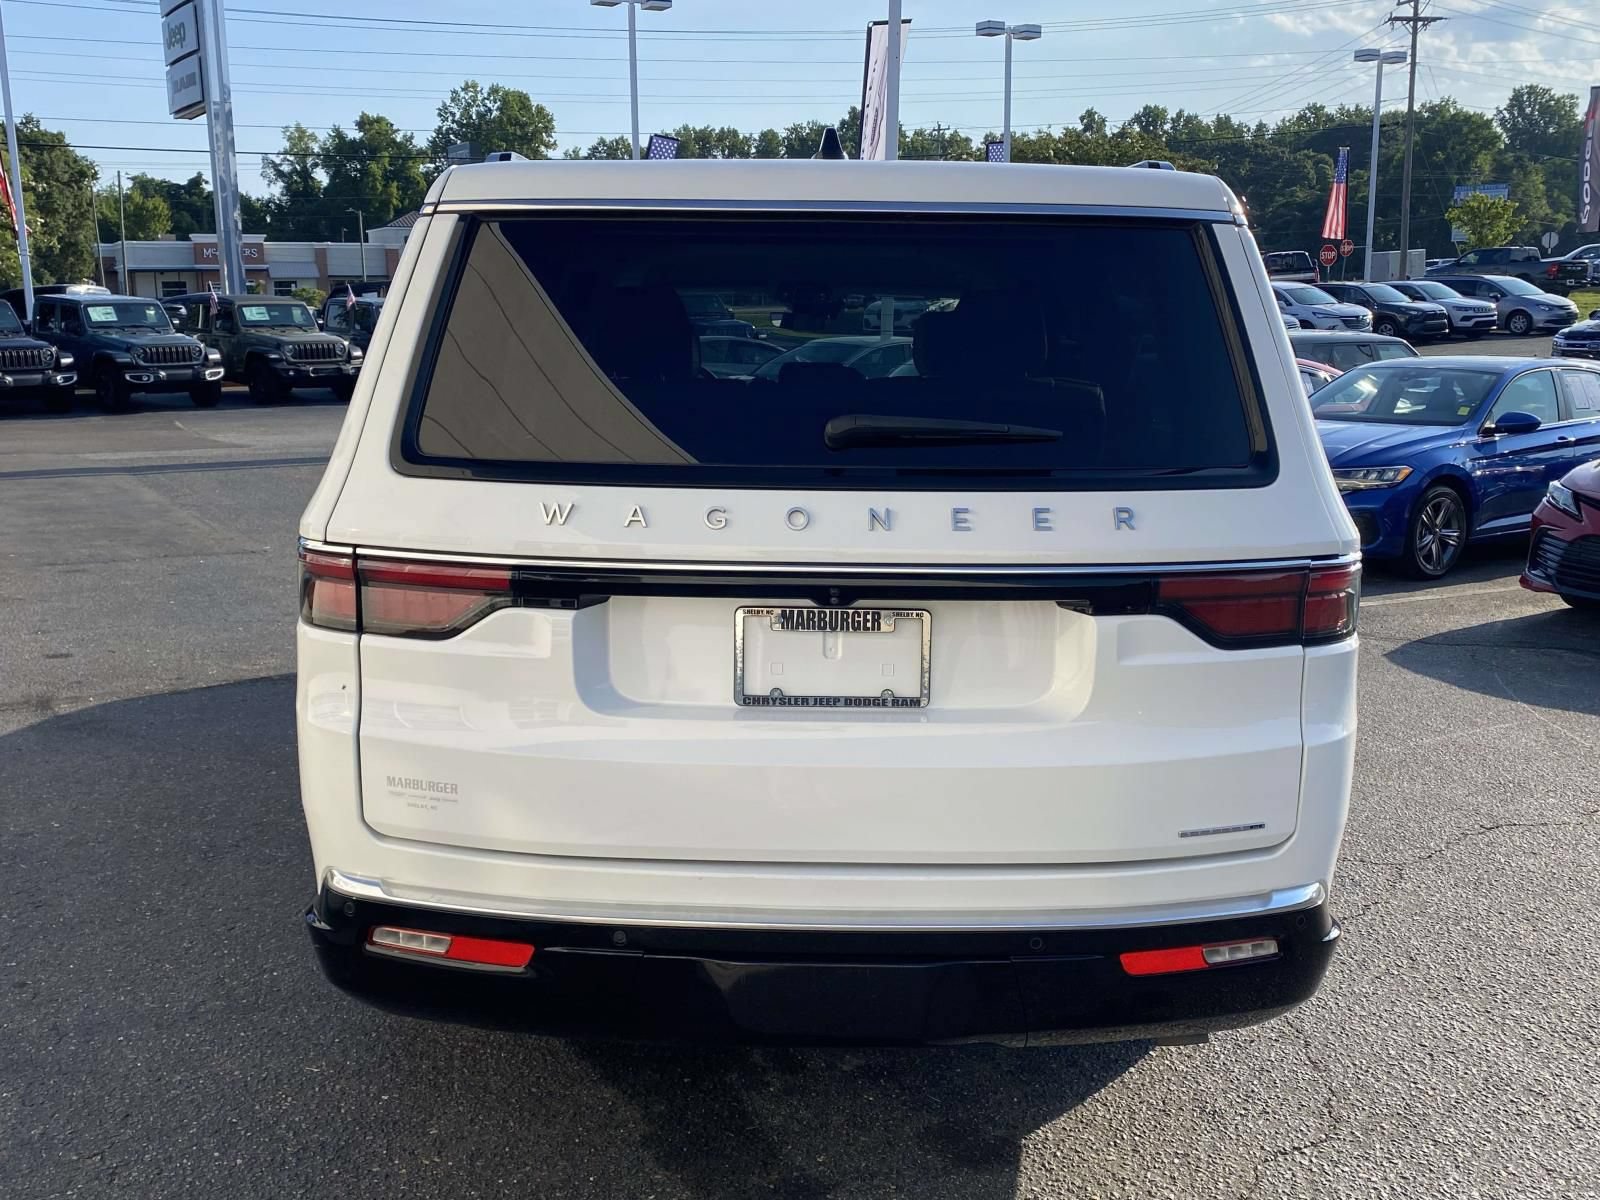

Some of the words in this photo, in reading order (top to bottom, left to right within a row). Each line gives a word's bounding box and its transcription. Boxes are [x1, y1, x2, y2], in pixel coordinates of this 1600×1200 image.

[1321, 251, 1336, 260] STOP
[539, 501, 1137, 533] WAGONEER
[780, 609, 882, 632] MARBURGER
[742, 696, 810, 706] CHRYSLER
[811, 697, 841, 706] JEEP
[844, 698, 889, 707] DODGE
[891, 698, 921, 707] RAM
[386, 775, 459, 795] MARBURGER
